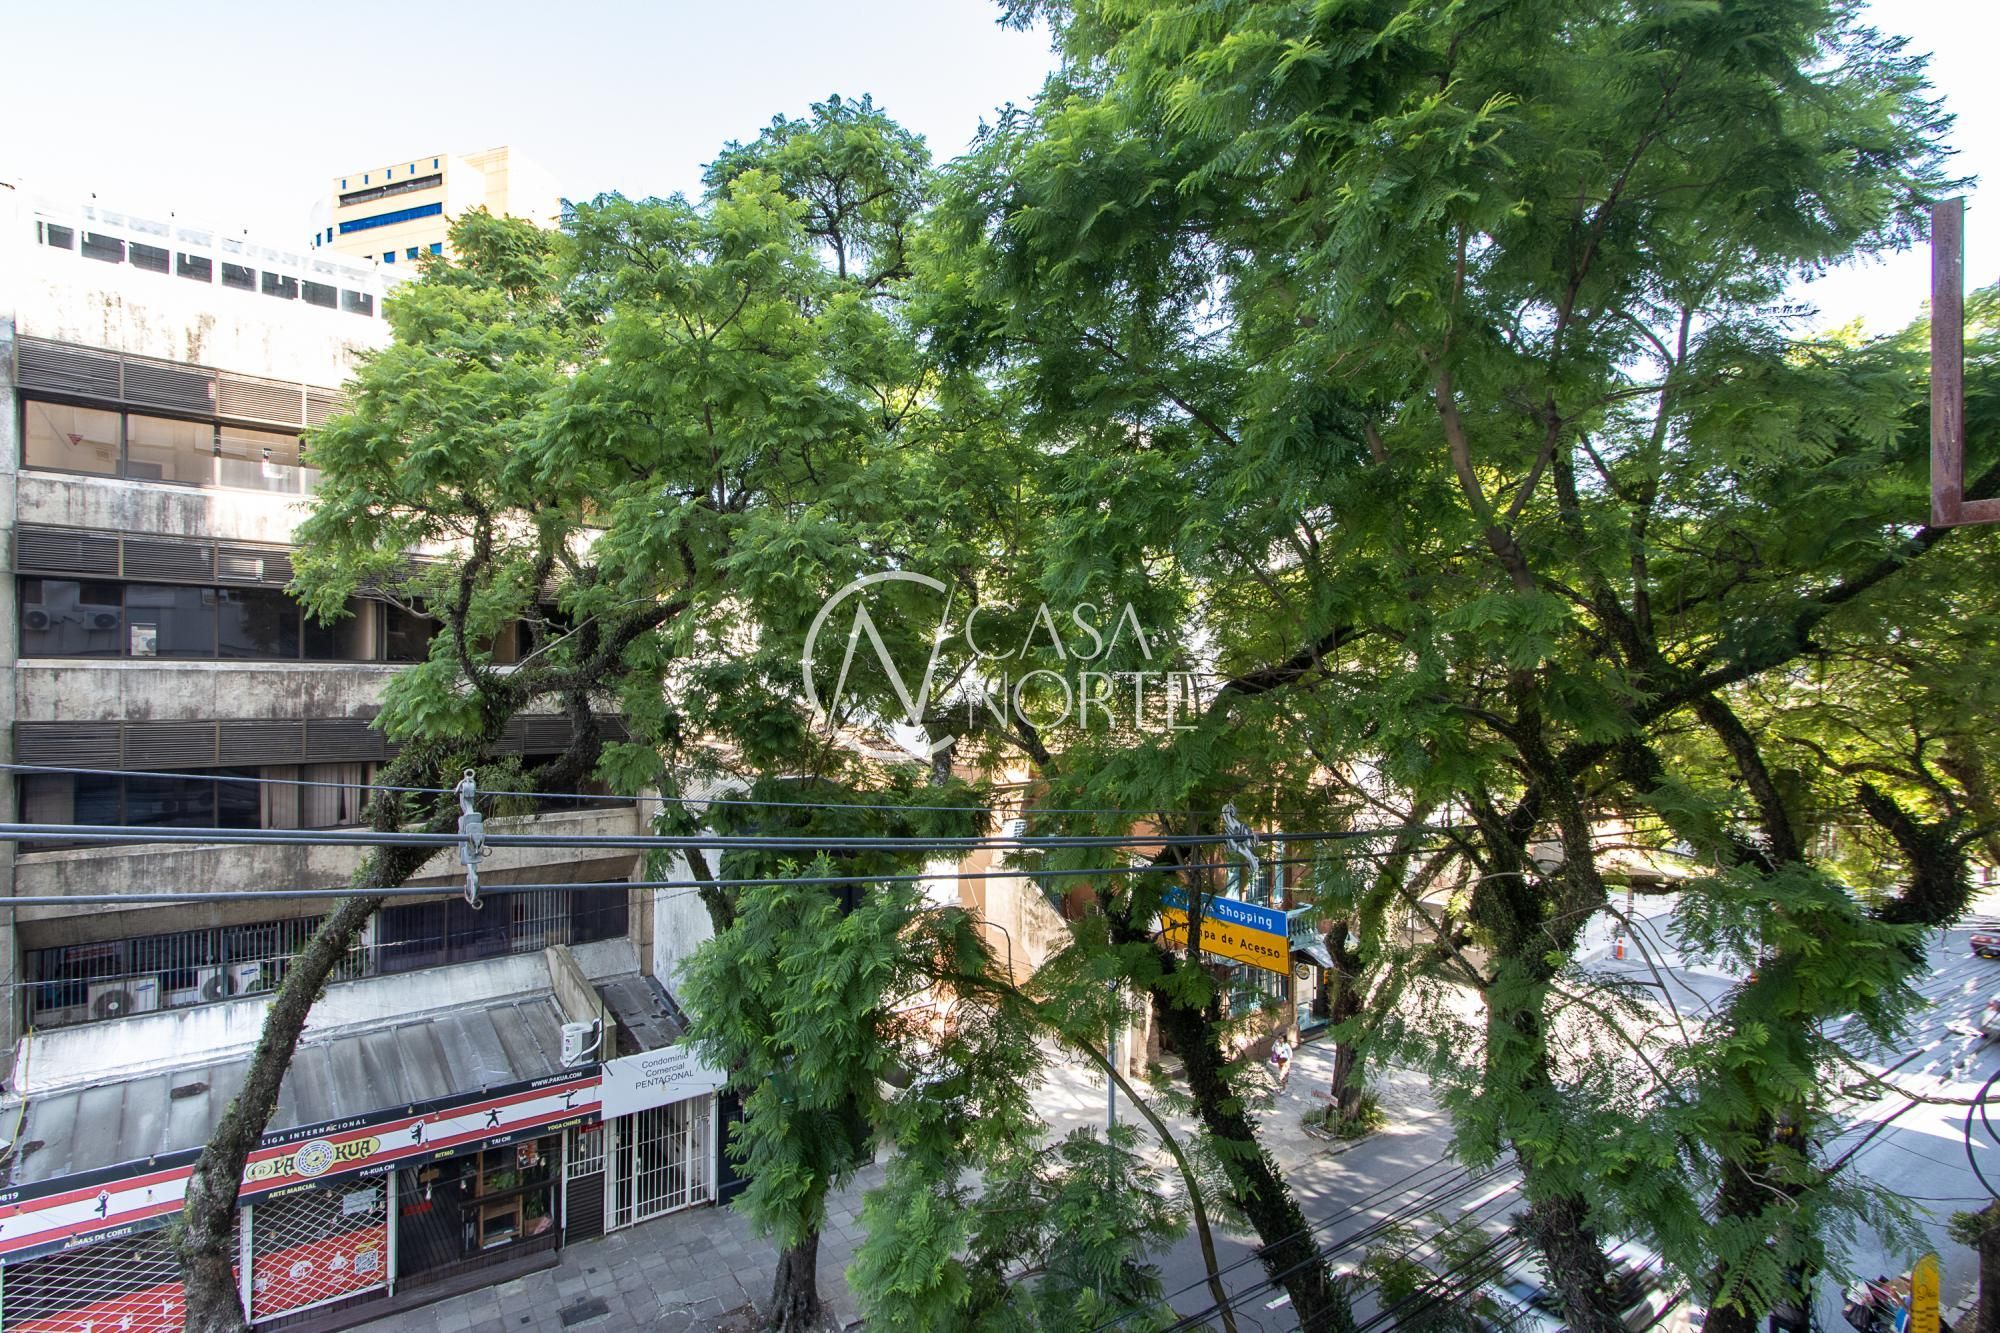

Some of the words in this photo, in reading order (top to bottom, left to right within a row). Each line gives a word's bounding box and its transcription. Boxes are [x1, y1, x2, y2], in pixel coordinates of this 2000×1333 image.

[1219, 904, 1273, 930] Shopping
[1221, 933, 1234, 945] de
[1240, 938, 1281, 959] Acesso
[645, 1062, 685, 1078] Comercial
[531, 1071, 582, 1087] WWW.PAKUA.COM
[635, 1069, 694, 1090] PENTAGONAL
[261, 1136, 285, 1146] LIGA
[289, 1118, 366, 1140] INTERNACIONAL
[547, 1123, 563, 1131] YOGA
[334, 1139, 371, 1161] KUA
[434, 1149, 455, 1159] RITMO
[359, 1166, 383, 1177] PA-KUA
[268, 1190, 285, 1199] ARTE
[286, 1182, 317, 1195] MARCIAL
[94, 1233, 105, 1241] DE
[106, 1226, 133, 1238] CORTE
